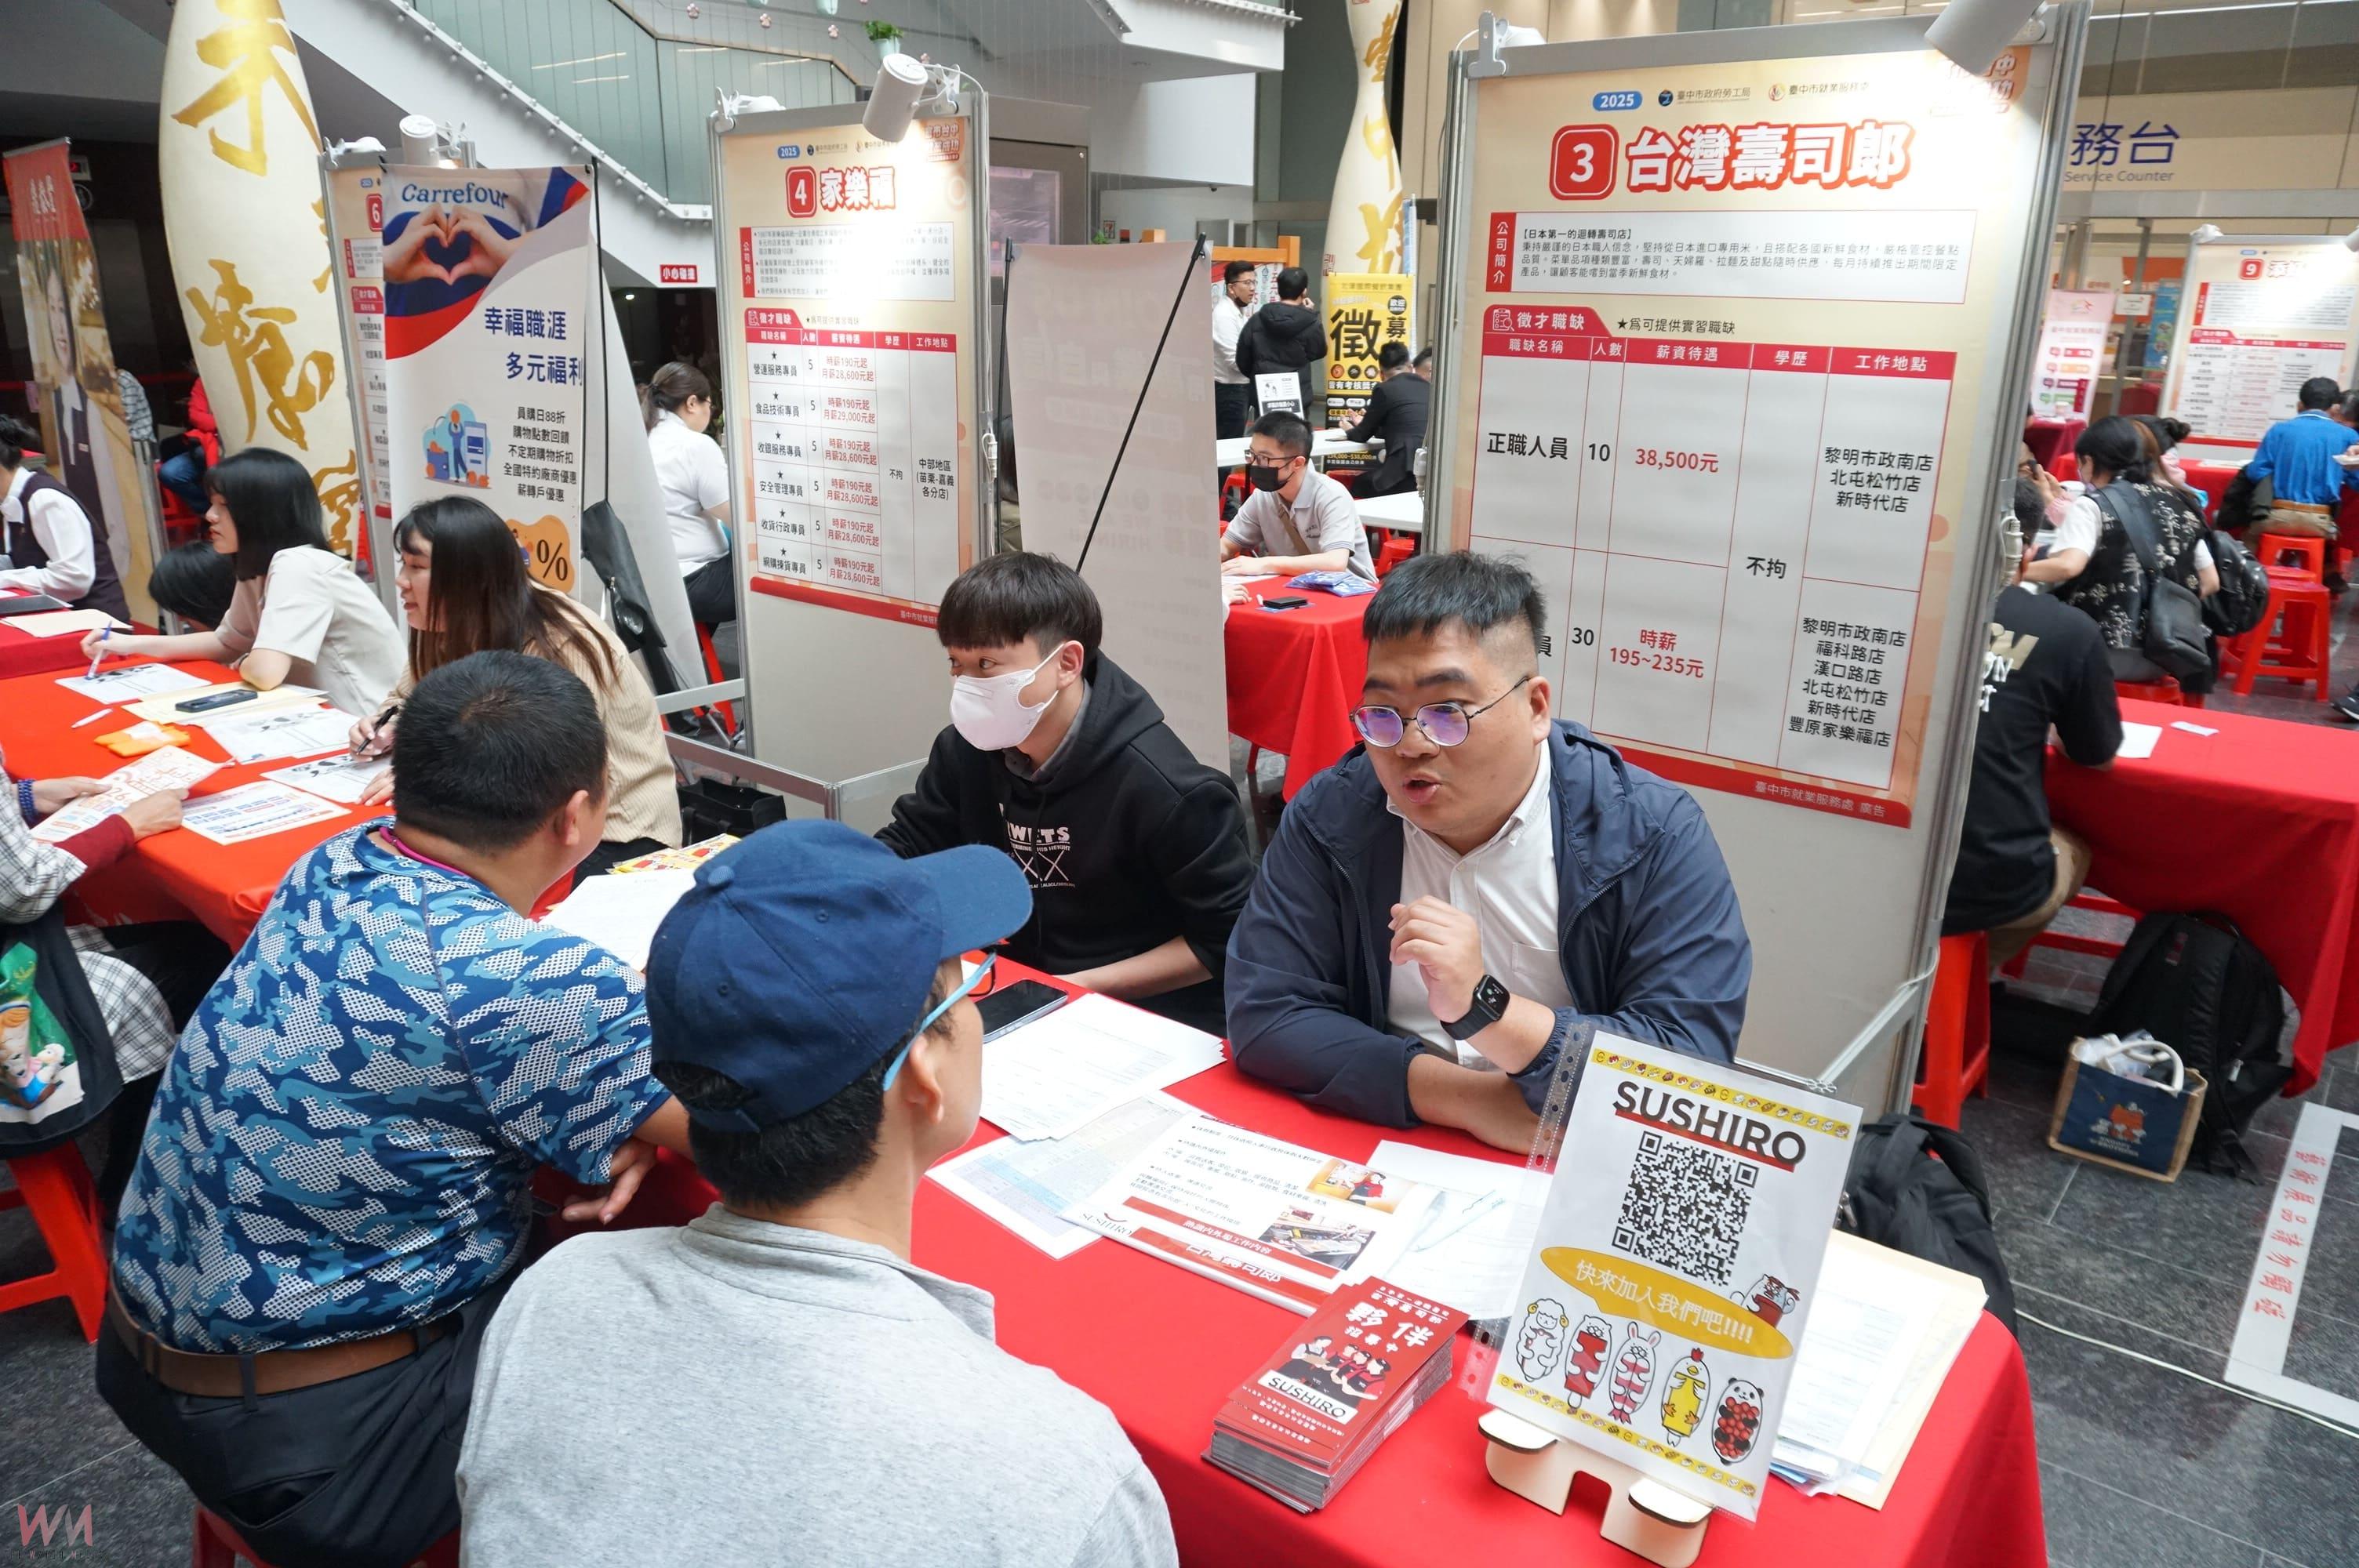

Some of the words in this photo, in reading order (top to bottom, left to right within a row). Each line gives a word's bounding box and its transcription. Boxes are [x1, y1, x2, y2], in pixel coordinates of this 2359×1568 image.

[1600, 94, 1634, 108] 2025
[781, 147, 797, 157] 2025
[2070, 121, 2180, 166] 務台
[1569, 143, 1594, 183] 3
[1627, 122, 1912, 191] 台灣壽司郎
[2064, 171, 2113, 182] Service
[2117, 170, 2174, 182] Counter
[402, 181, 509, 209] Carrefour
[794, 179, 807, 206] 4
[372, 202, 380, 223] 6
[1493, 221, 1509, 284] 公司簡介
[2246, 263, 2257, 276] 9
[485, 307, 566, 340] 幸福職涯
[1517, 311, 1585, 330] 徵才職缺
[916, 337, 948, 347] 工作地點
[1330, 308, 1383, 362] 徵
[809, 359, 813, 370] 5
[827, 356, 868, 368] 時薪190元起
[1509, 338, 1564, 354] 職缺名稱
[1594, 342, 1623, 357] 人數
[1656, 345, 1718, 361] 薪資待遇
[1775, 350, 1808, 366] 學歷
[1856, 354, 1928, 372] 工作地點
[506, 351, 583, 386] 多元福利
[810, 400, 816, 411] 5
[828, 397, 870, 410] 時薪190元起
[517, 406, 566, 424] 員購日88折
[513, 425, 569, 445] 購物點數回饋
[829, 437, 871, 452] 時薪190元起
[508, 445, 573, 464] 不定期購物折扣
[812, 441, 816, 452] 5
[1487, 432, 1568, 460] 正職人員
[1589, 443, 1610, 462] 10
[1635, 448, 1718, 473] 38,500元
[919, 459, 951, 472] 中部地區
[1825, 446, 1933, 471] 黎明市政南店
[503, 463, 577, 485] 全國特約廠商優惠
[889, 469, 903, 480] 不拘
[916, 472, 954, 487] (苗栗-嘉義
[1830, 469, 1921, 492] 北屯松竹店
[518, 484, 565, 503] 薪轉戶優惠
[814, 481, 819, 491] 5
[831, 478, 872, 493] 時薪190元起
[922, 486, 949, 501] 各分店)
[1836, 491, 1909, 513] 新時代店
[816, 521, 820, 531] 5
[832, 517, 874, 533] 時薪190元起
[816, 559, 822, 569] 5
[834, 557, 874, 573] 時薪190元起
[1747, 556, 1787, 579] 不拘
[1572, 627, 1594, 646] 30
[1640, 630, 1677, 652] 時薪
[1802, 617, 1906, 648] 黎明市政南店
[1816, 639, 1886, 665] 福科路店
[1610, 647, 1704, 679] 195~235元
[1813, 659, 1882, 685] 漢口路店
[1802, 679, 1888, 706] 北屯松竹店
[1808, 699, 1877, 724] 新時代店
[1789, 715, 1891, 747] 豐原家樂福店
[1755, 780, 1855, 811] 臺中市就業服務處
[1860, 800, 1886, 817] 廣告
[1614, 1081, 1806, 1165] SUSHIRO
[1576, 1258, 1754, 1345] 快來加入我們吧!!!!
[1267, 1376, 1347, 1419] SUSHIRO
